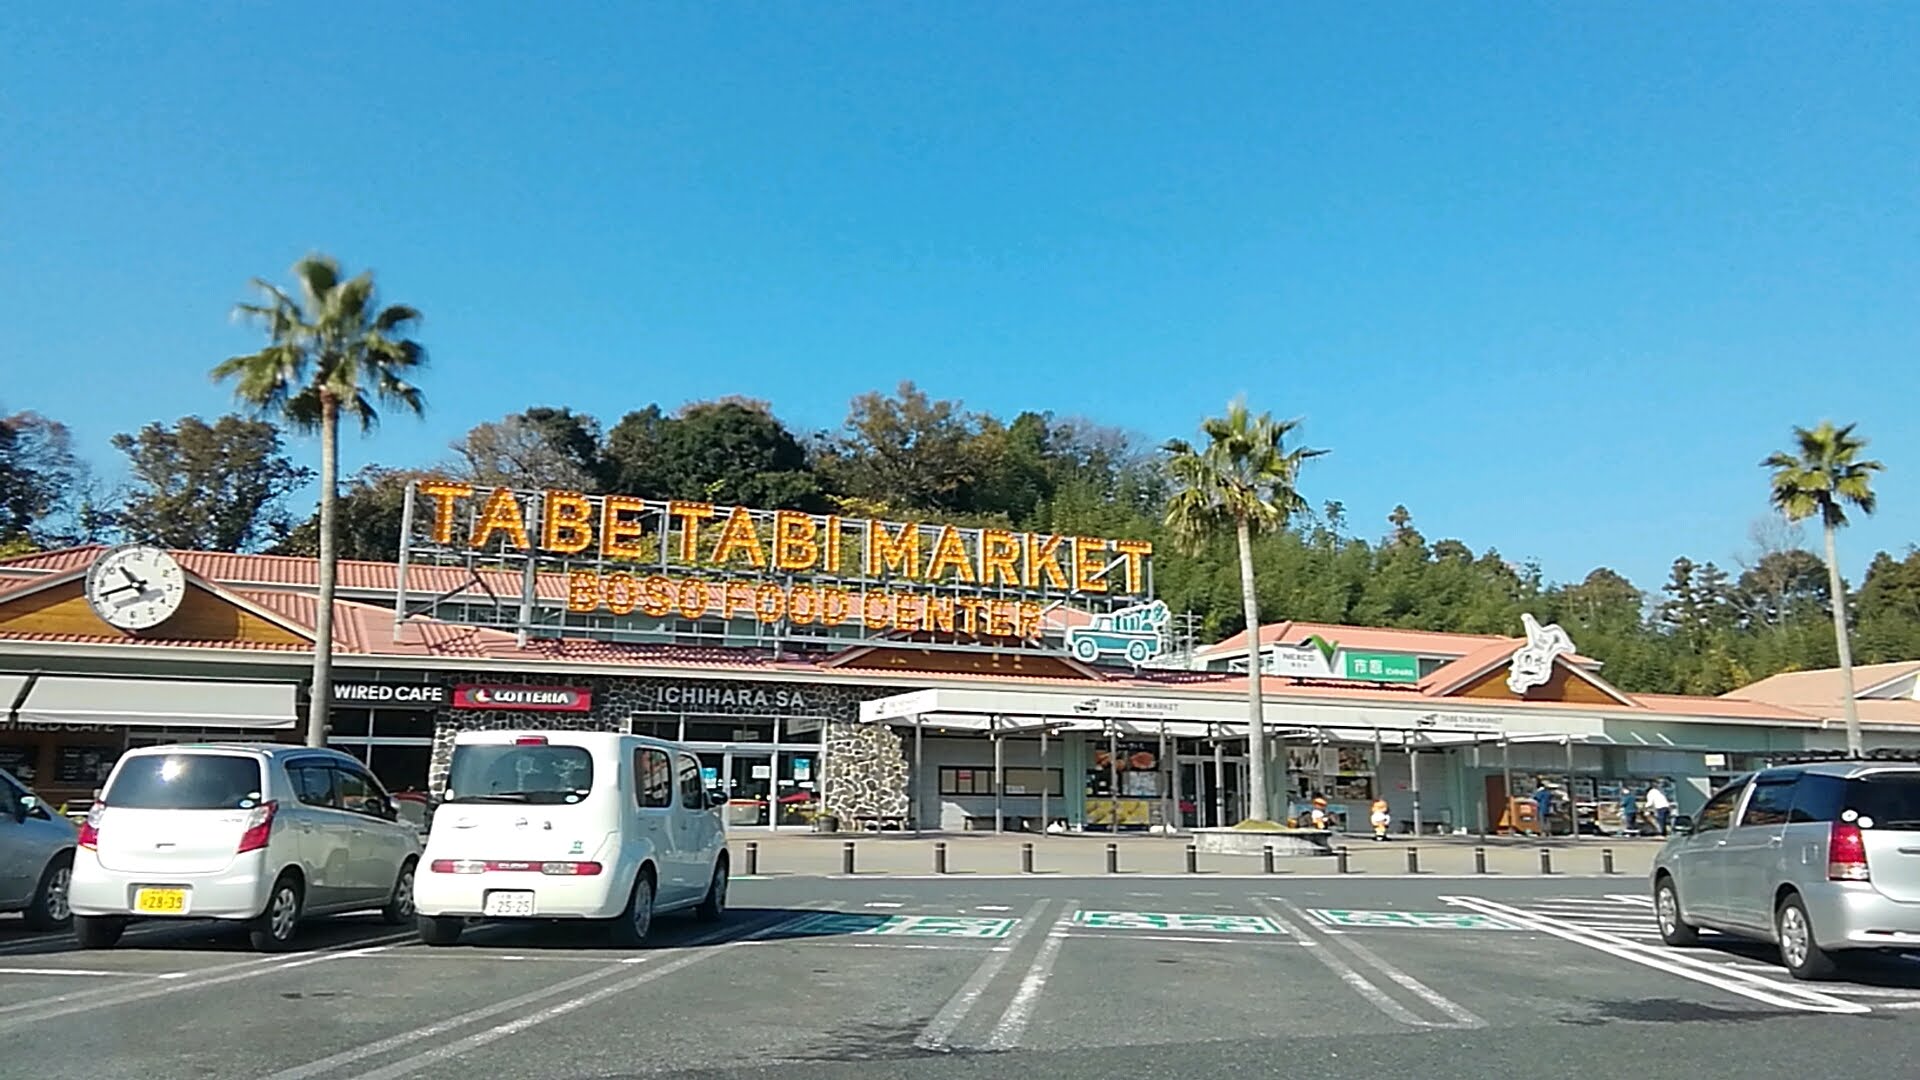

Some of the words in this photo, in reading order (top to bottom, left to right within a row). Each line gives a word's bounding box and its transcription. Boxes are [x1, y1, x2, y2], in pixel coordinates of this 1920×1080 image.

[419, 480, 644, 559] TABE
[669, 501, 840, 573] TABI
[866, 520, 1151, 594] MARKET
[568, 570, 710, 619] BOSO
[723, 580, 849, 626] FOOD
[862, 590, 1043, 639] CENTER
[334, 684, 393, 700] WIRED
[395, 686, 442, 701] CAFE
[494, 690, 569, 703] LOTTERIA
[657, 686, 769, 706] ICHIHARA
[775, 691, 805, 707] SA
